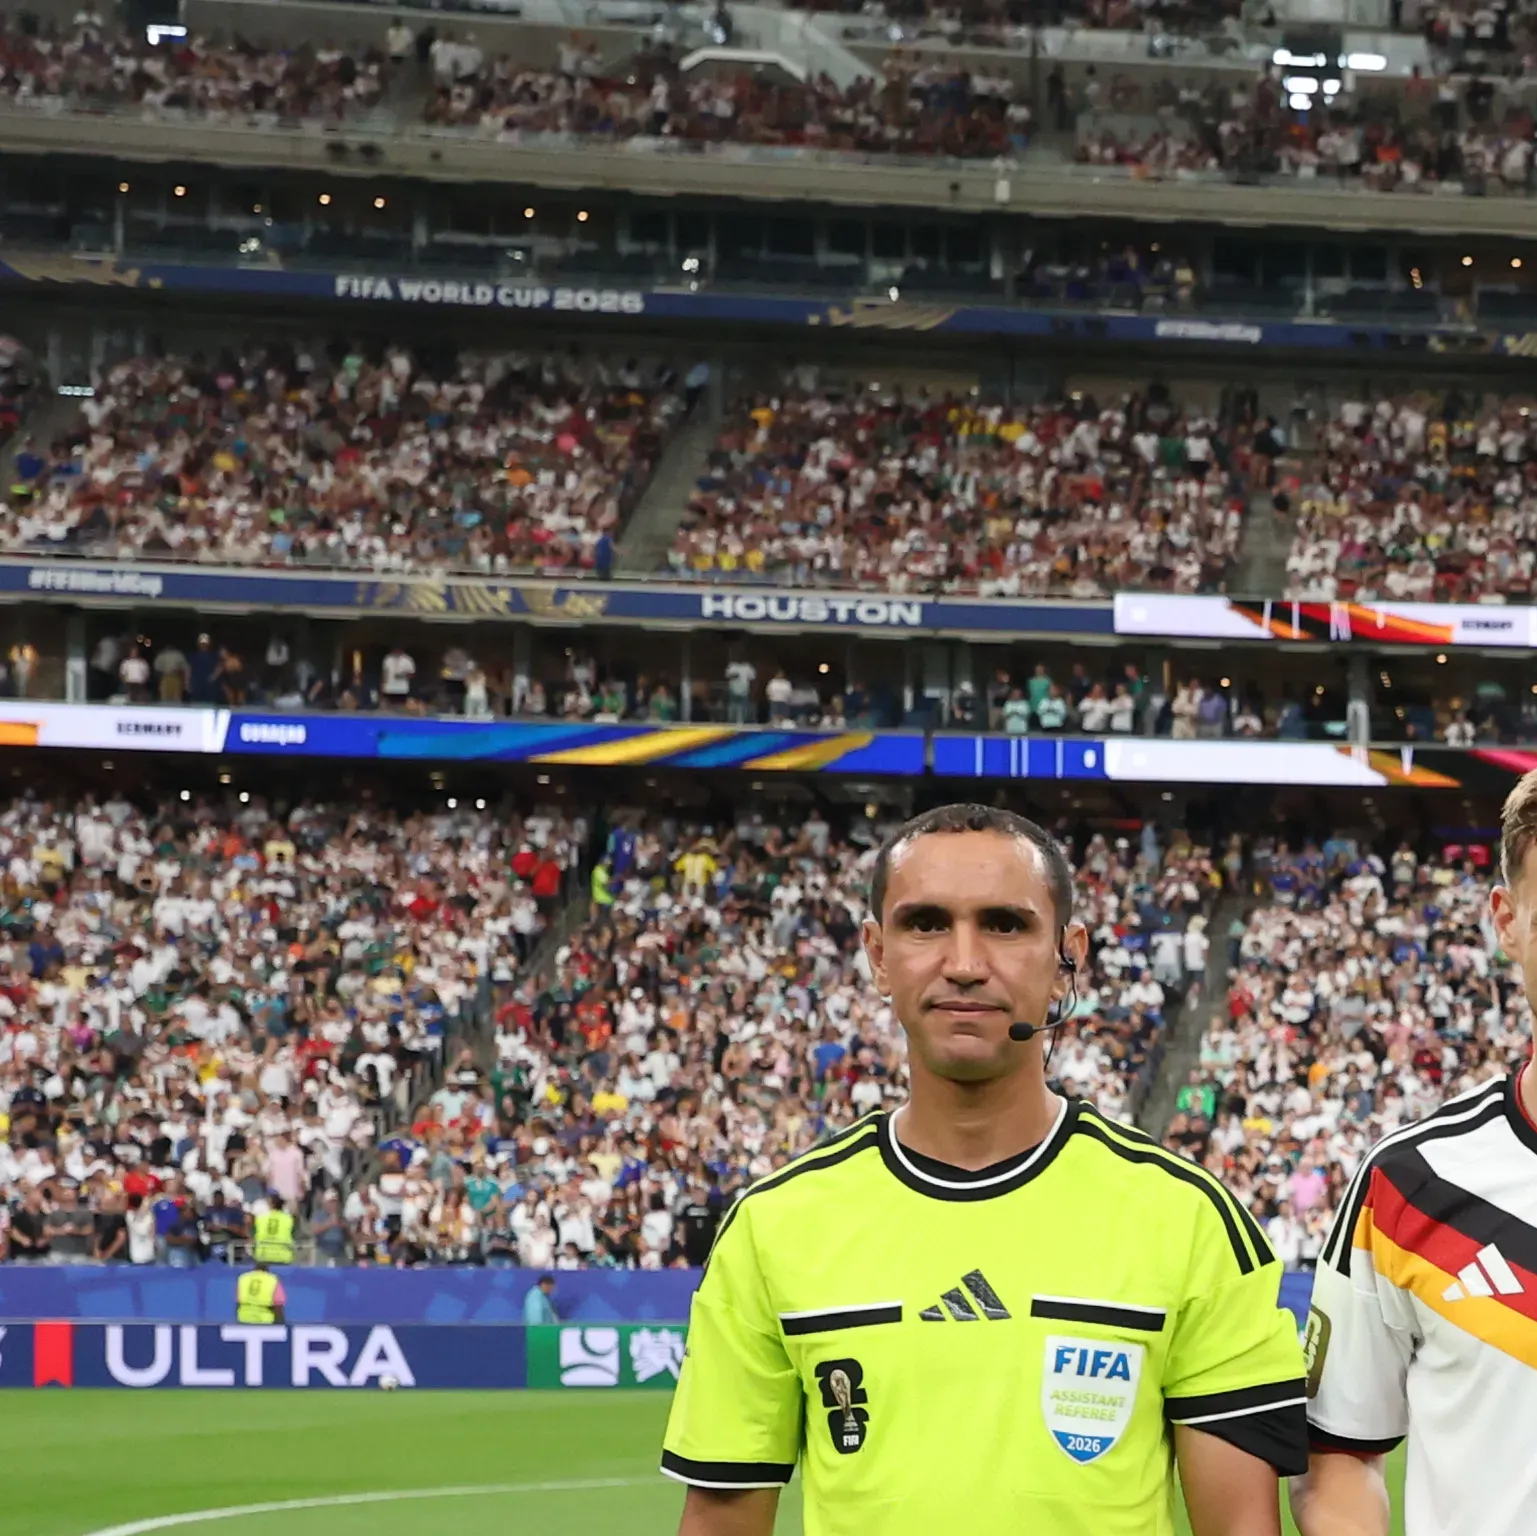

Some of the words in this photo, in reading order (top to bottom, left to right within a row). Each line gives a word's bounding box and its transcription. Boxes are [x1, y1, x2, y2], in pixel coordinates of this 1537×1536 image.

[335, 274, 393, 299] FIFA
[398, 277, 494, 305] WORLD
[497, 284, 550, 308] CUP
[553, 287, 645, 313] 2026
[701, 594, 923, 626] HOUSTON
[105, 1325, 416, 1387] ULTRA
[1054, 1346, 1130, 1381] FIFA
[1050, 1389, 1126, 1408] ASSISTANT
[1053, 1403, 1117, 1421] REFEREE
[1066, 1436, 1101, 1453] 2026
